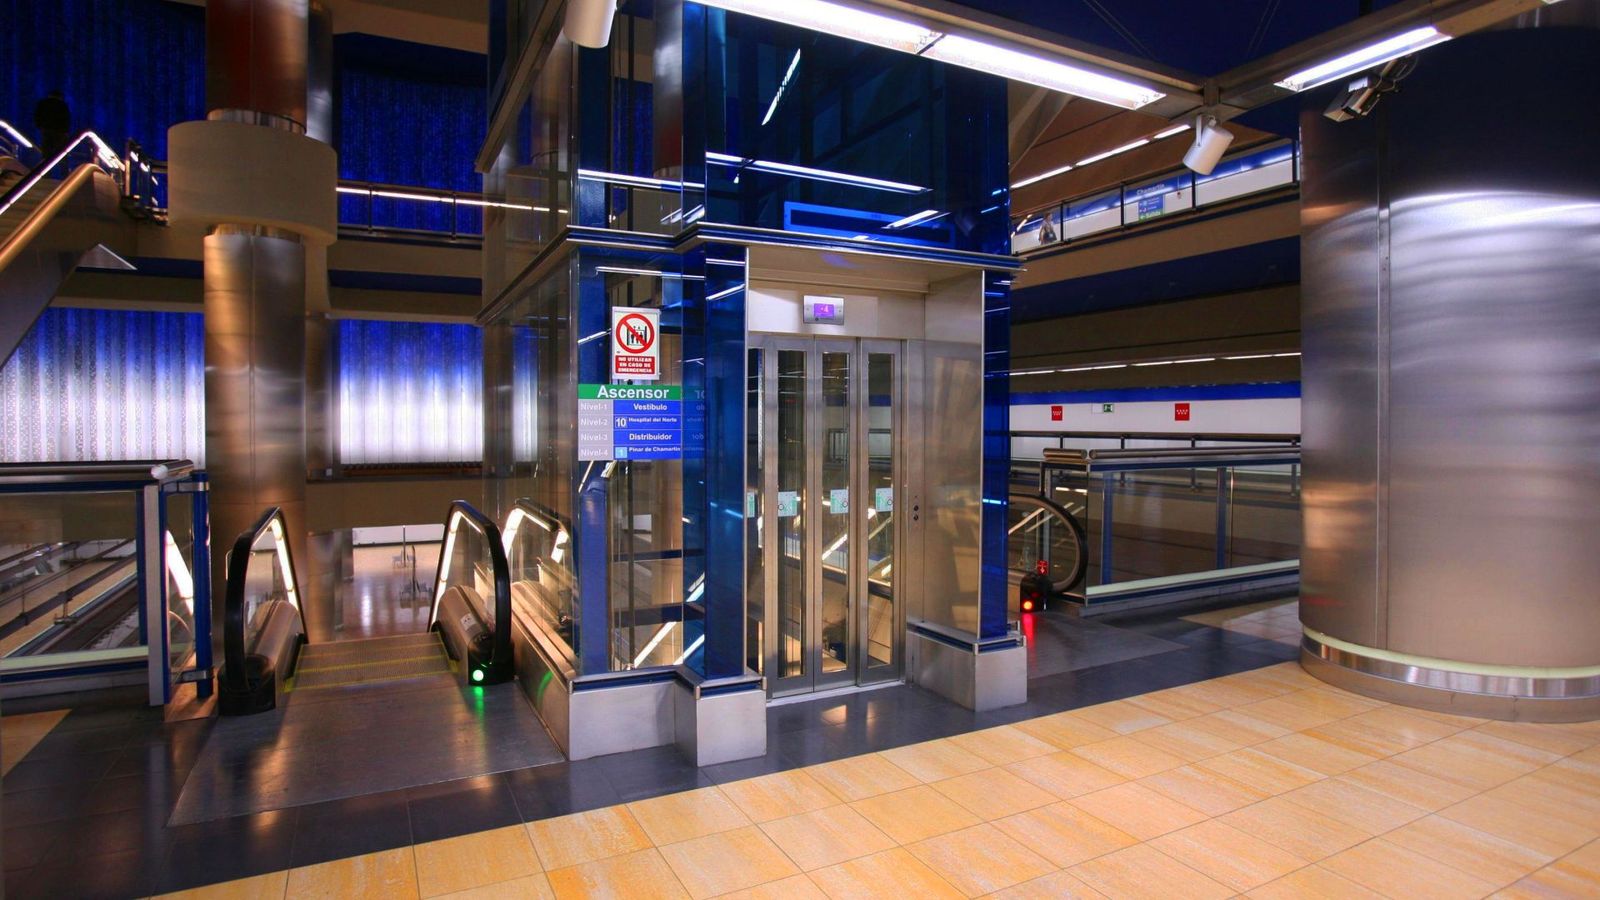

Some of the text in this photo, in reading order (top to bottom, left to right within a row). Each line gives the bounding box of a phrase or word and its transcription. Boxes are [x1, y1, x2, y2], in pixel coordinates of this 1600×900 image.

[597, 385, 669, 399] Ascensor
[580, 402, 608, 410] Nivel-1
[580, 417, 608, 426] Nivel-2
[615, 417, 627, 427] 10
[580, 433, 608, 441] Nivel-3
[629, 433, 672, 441] Distribuidor
[580, 448, 609, 457] Nivel-4
